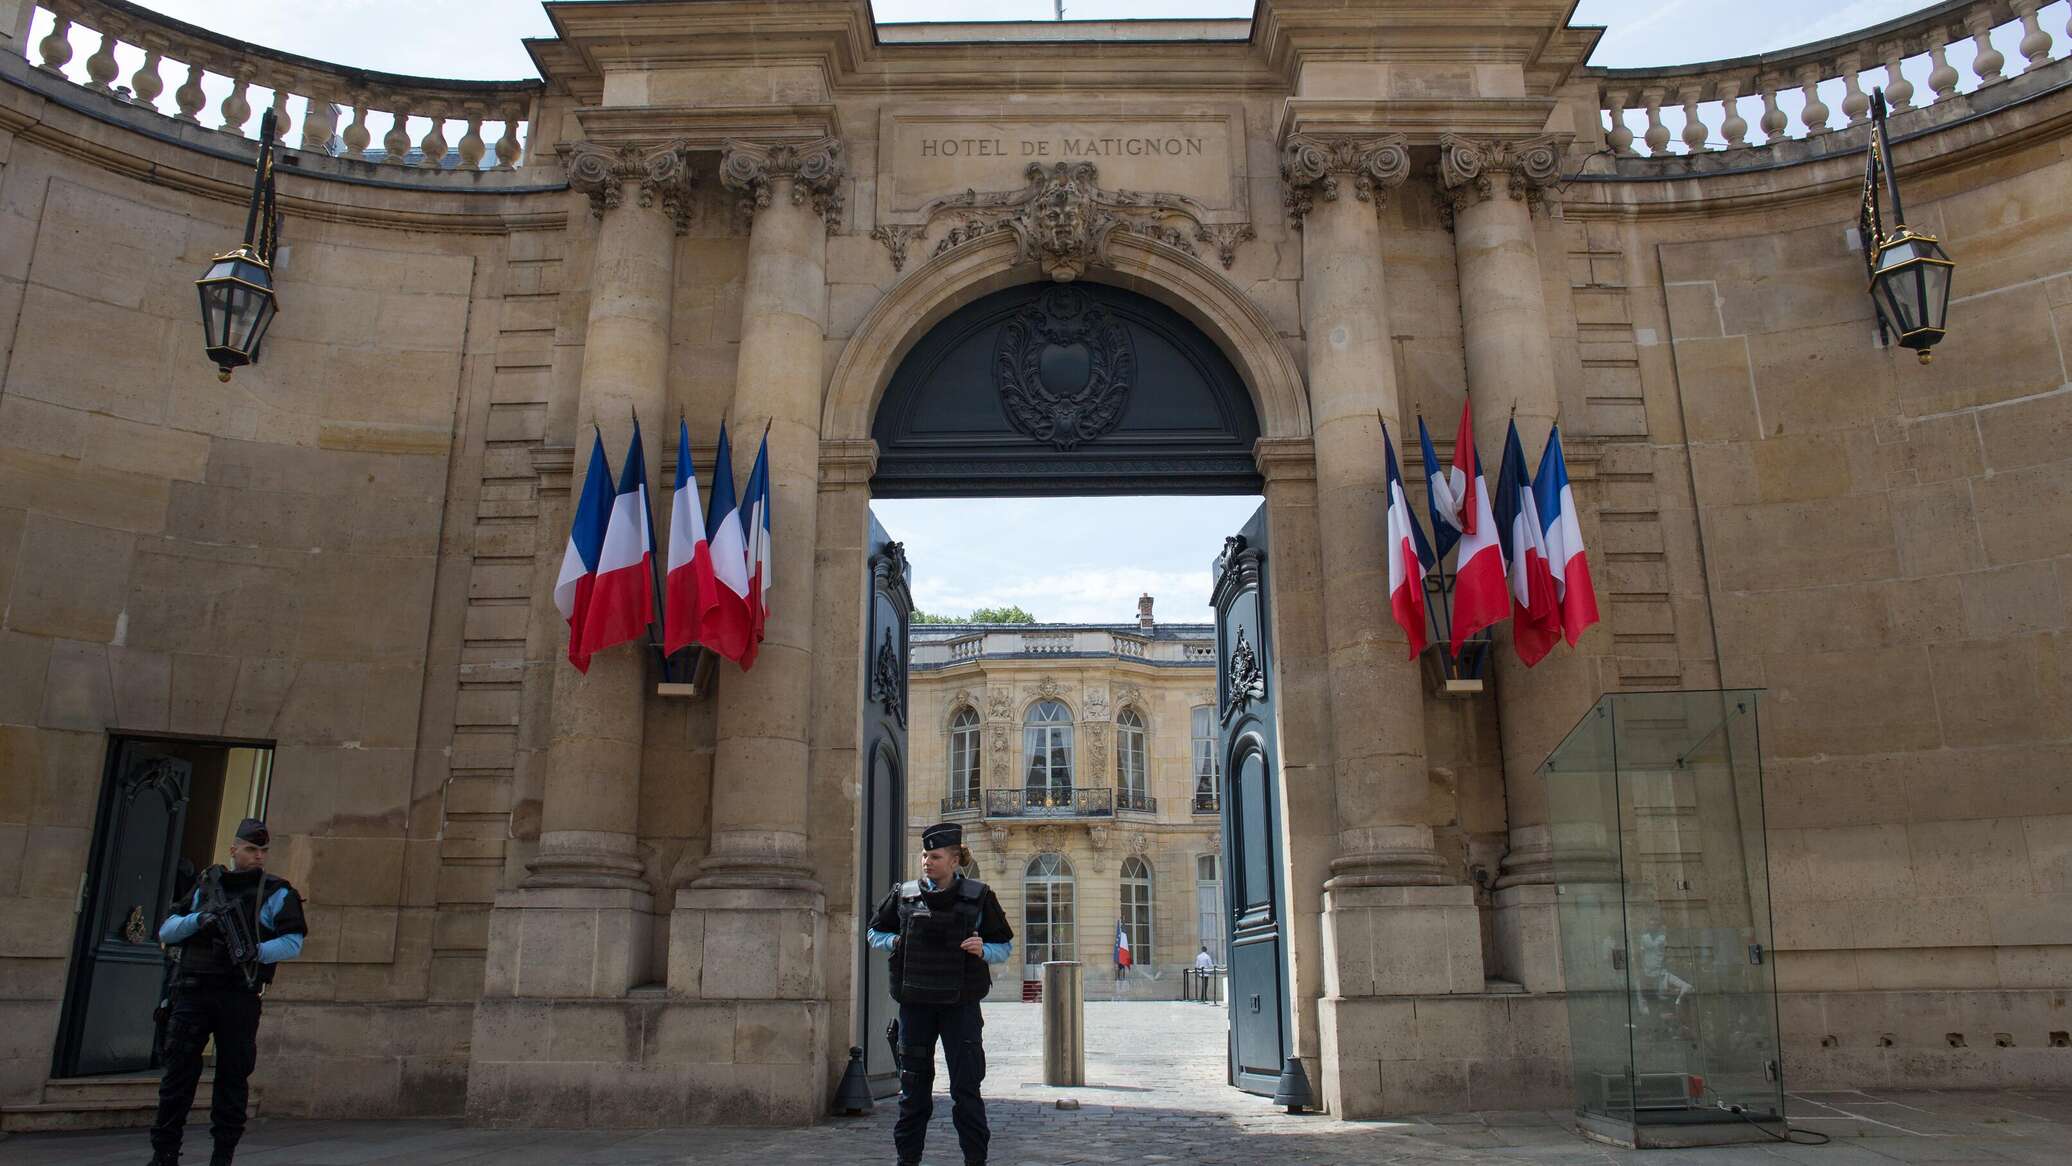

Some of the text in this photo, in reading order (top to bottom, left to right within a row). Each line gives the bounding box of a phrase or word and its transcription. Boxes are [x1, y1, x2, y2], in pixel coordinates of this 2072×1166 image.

[920, 138, 1203, 157] HOTEL DE MATIGNON
[1426, 574, 1457, 593] 57
